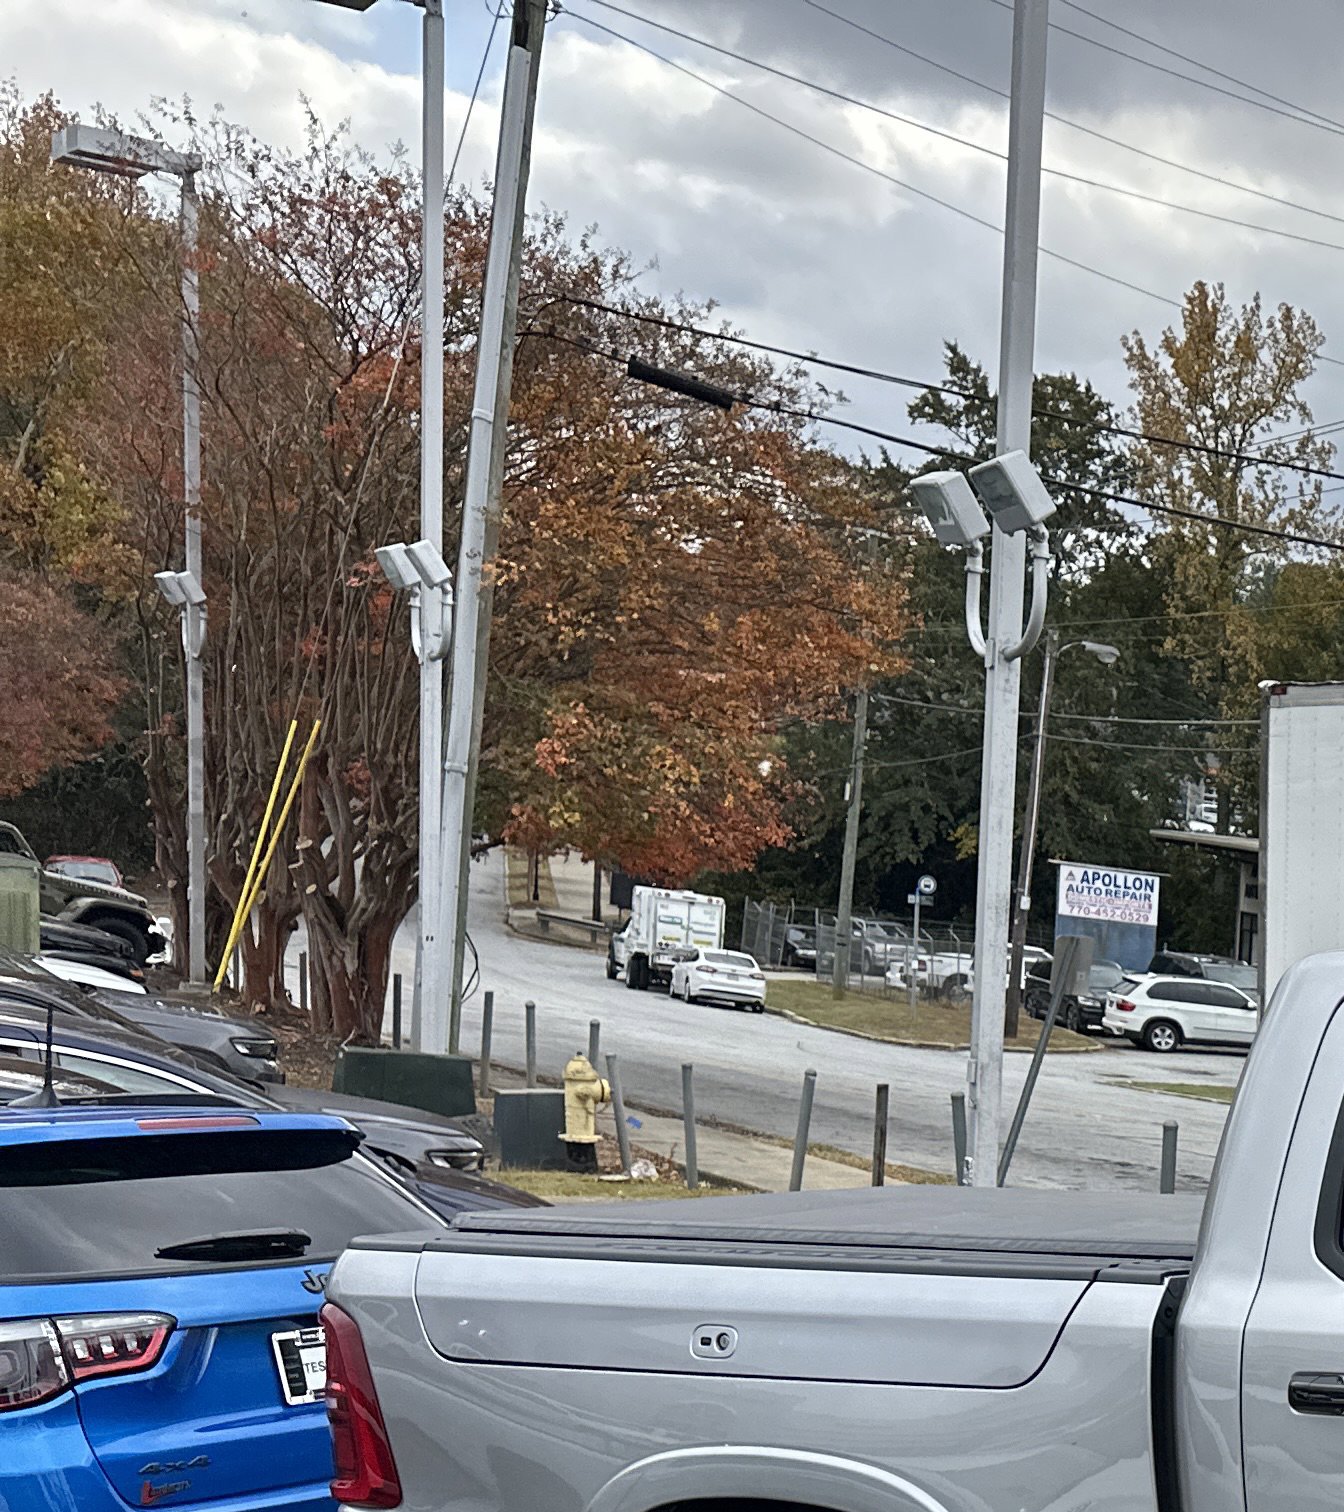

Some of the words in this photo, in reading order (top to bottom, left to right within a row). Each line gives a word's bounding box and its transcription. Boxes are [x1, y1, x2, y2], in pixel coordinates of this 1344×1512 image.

[1080, 870, 1155, 893] APOLLON
[1066, 884, 1103, 897] AUTO
[1105, 888, 1152, 902] REPAIR
[1068, 905, 1150, 923] 770-452-0529
